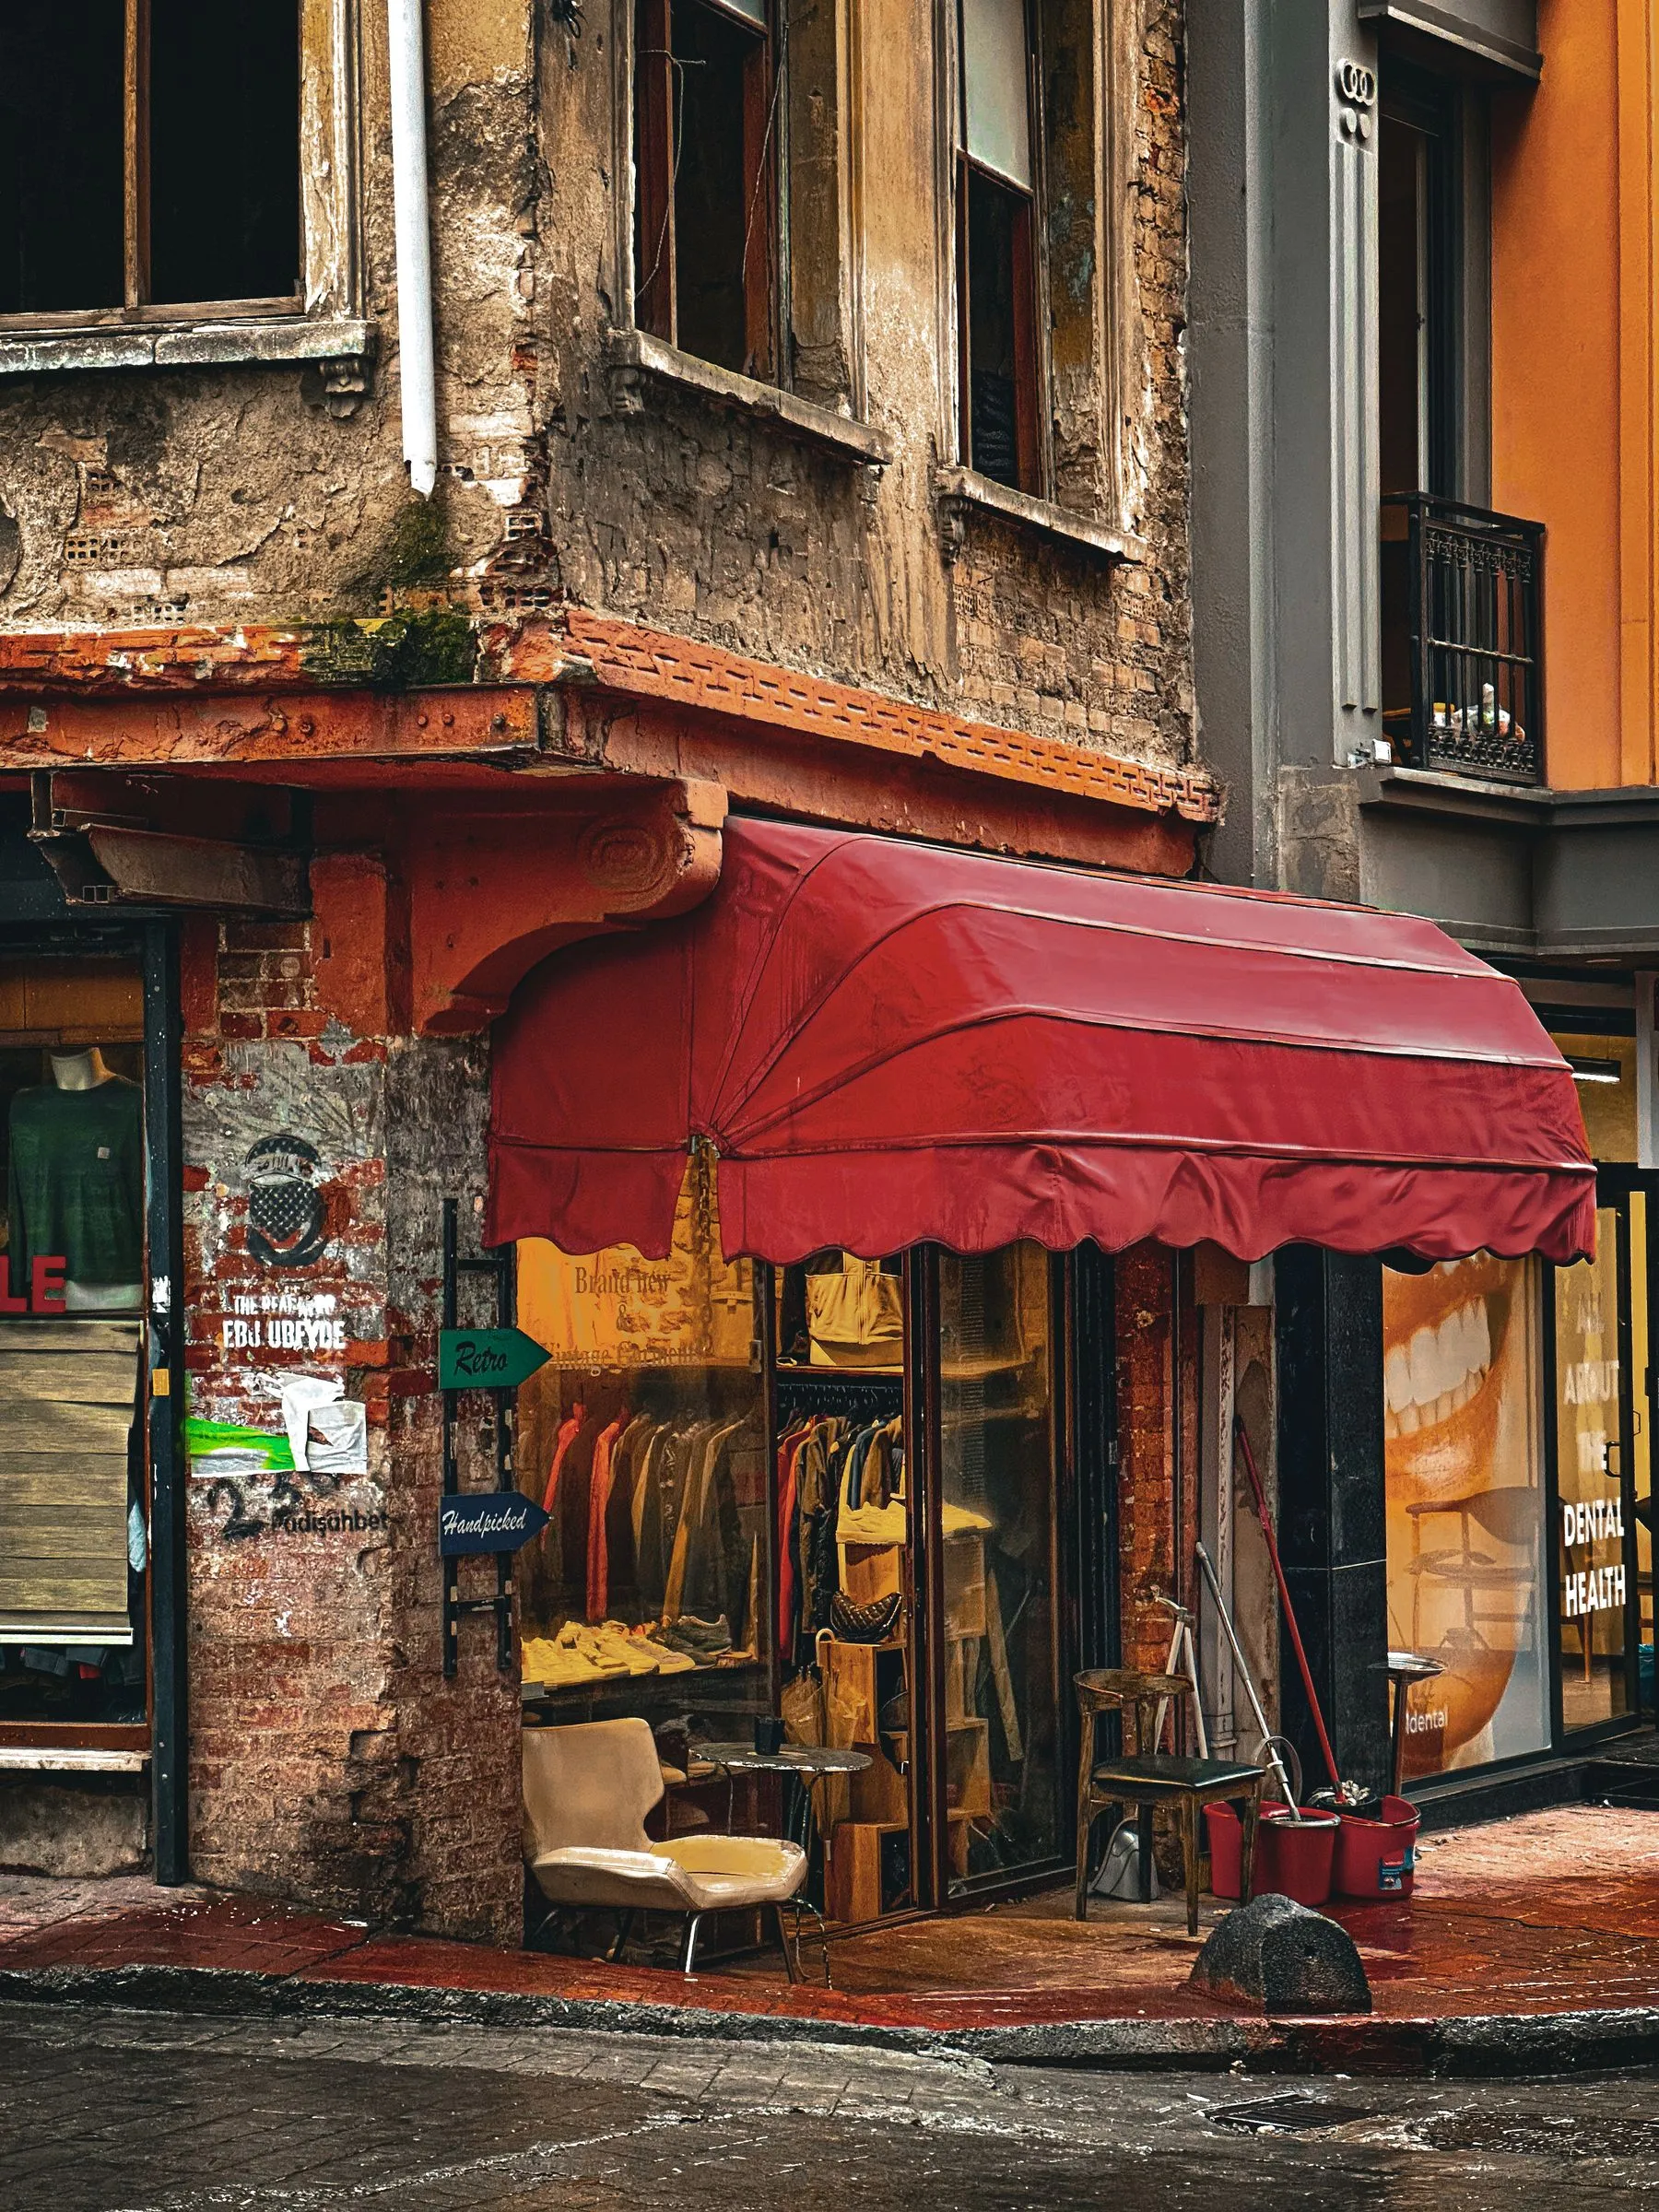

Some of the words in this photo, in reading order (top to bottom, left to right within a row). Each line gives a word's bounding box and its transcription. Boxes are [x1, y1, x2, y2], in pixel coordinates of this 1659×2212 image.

[575, 1266, 630, 1294] Brand
[234, 1295, 258, 1315] THE
[453, 1341, 508, 1376] Retro
[1564, 1359, 1619, 1405] ABOUT
[441, 1507, 527, 1538] Handpicked
[1563, 1497, 1625, 1547] DENTAL
[1565, 1564, 1626, 1618] HEALTH
